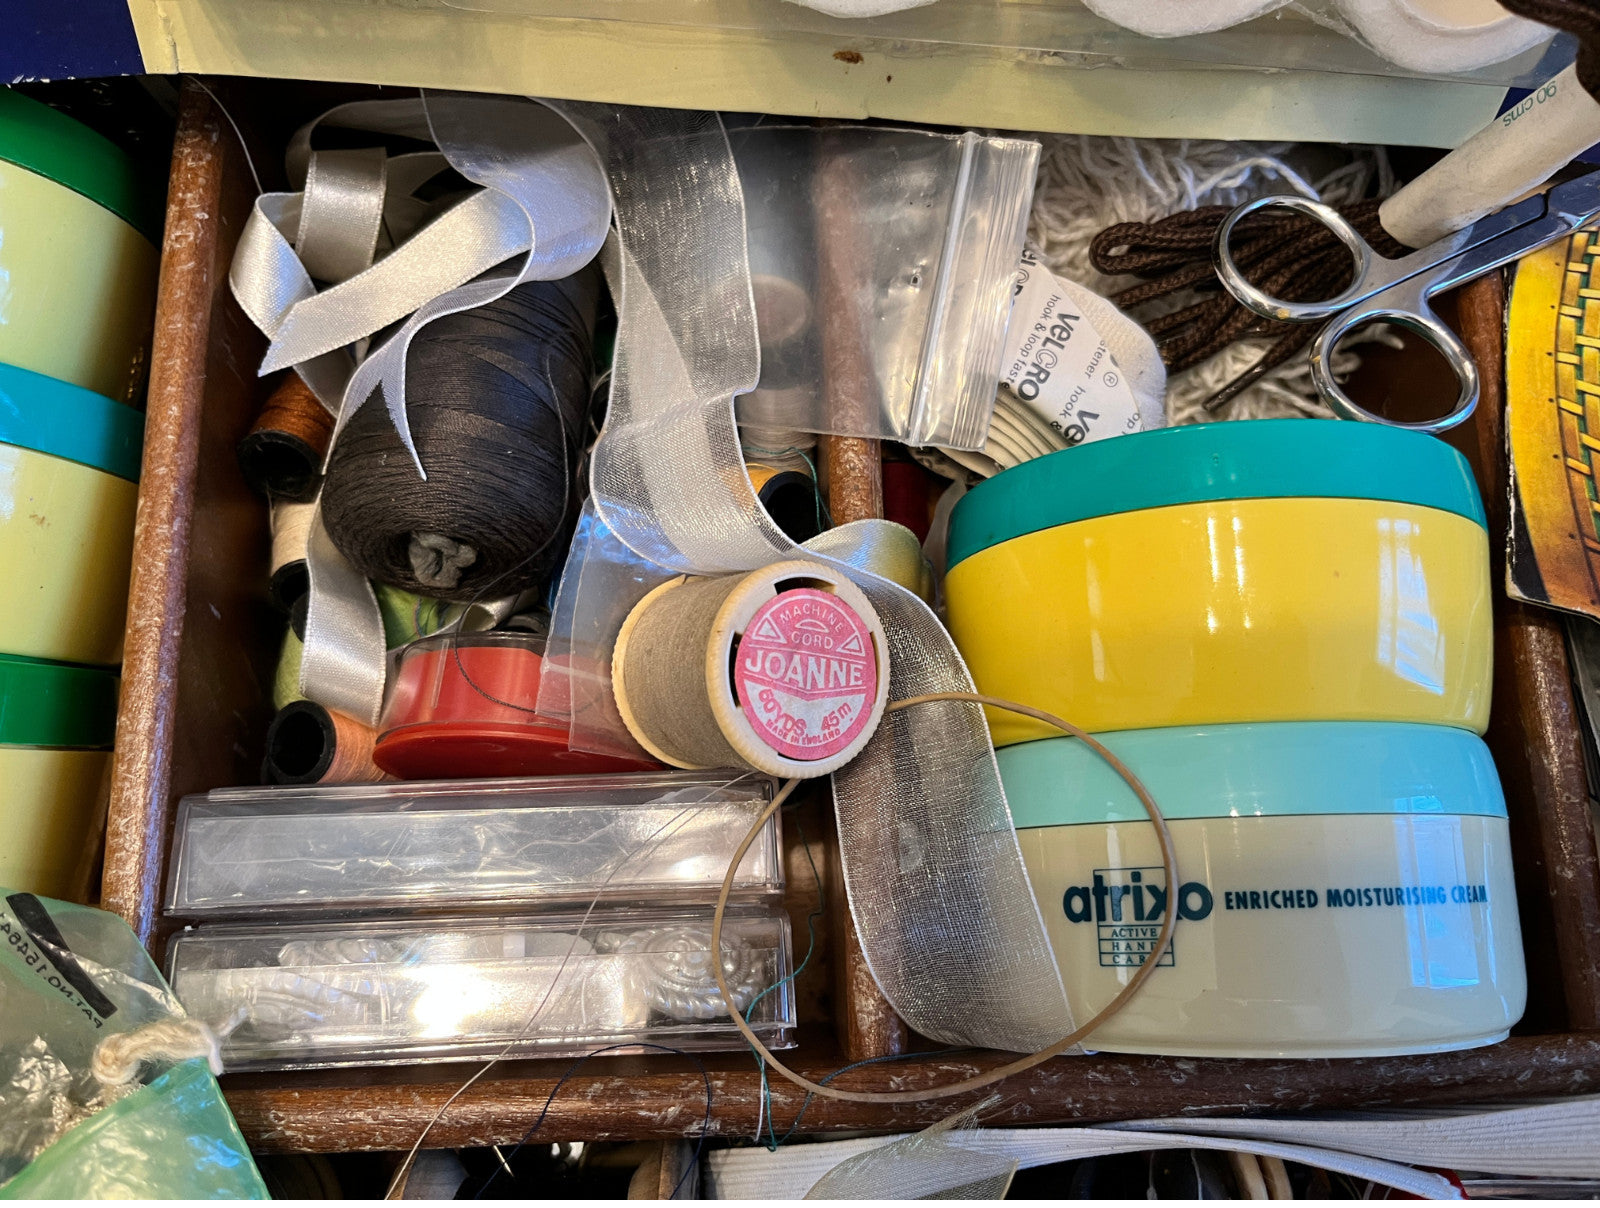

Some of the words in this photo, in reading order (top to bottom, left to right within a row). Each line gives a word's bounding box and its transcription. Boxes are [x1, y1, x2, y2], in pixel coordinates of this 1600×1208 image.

[1537, 80, 1557, 104] 90
[1502, 97, 1534, 127] cms
[1040, 294, 1062, 321] hook
[1034, 322, 1047, 333] &
[1020, 332, 1041, 357] loop
[1059, 385, 1086, 418] hook
[780, 603, 843, 633] MACHINE
[791, 631, 834, 650] CORD
[746, 650, 863, 690] JOANNE
[766, 720, 788, 741] MADE
[802, 728, 841, 746] ENGLAND
[1063, 871, 1213, 923] atrixo
[1225, 889, 1319, 910] ENRICHED
[1327, 885, 1447, 908] MOISTURISING
[1452, 883, 1488, 904] CREAM
[1111, 927, 1158, 938] ACTIVE
[1112, 954, 1147, 964] CAR
